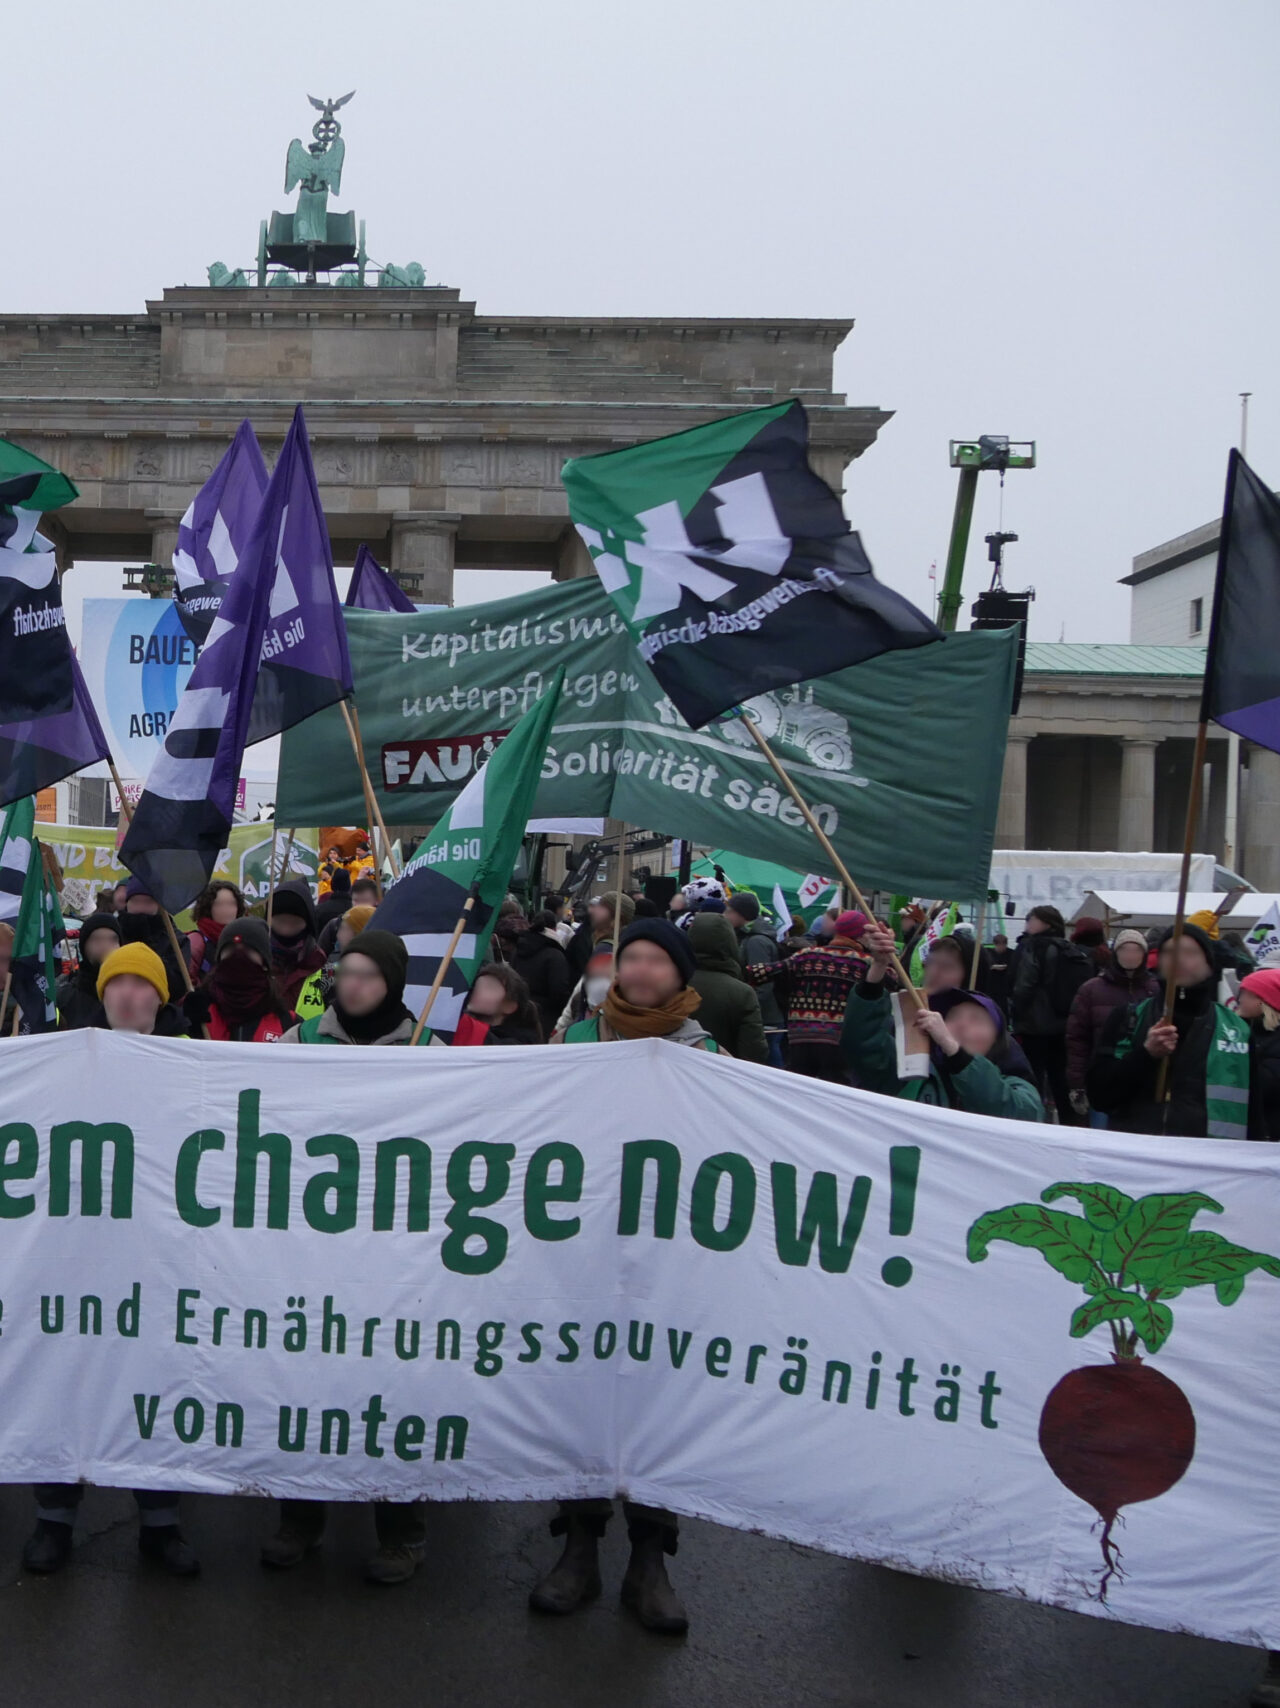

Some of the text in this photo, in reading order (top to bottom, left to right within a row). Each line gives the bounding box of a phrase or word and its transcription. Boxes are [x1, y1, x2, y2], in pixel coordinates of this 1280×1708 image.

[401, 612, 629, 668] Kapitalismu
[383, 744, 473, 786] FAU
[540, 738, 839, 836] Solidarität säen
[1217, 1040, 1248, 1054] FAU
[174, 1088, 586, 1275] change
[617, 1139, 921, 1287] now!
[41, 1282, 142, 1338] und
[176, 1288, 1002, 1431] Ernährungssouveränität
[134, 1392, 470, 1462] von unten
